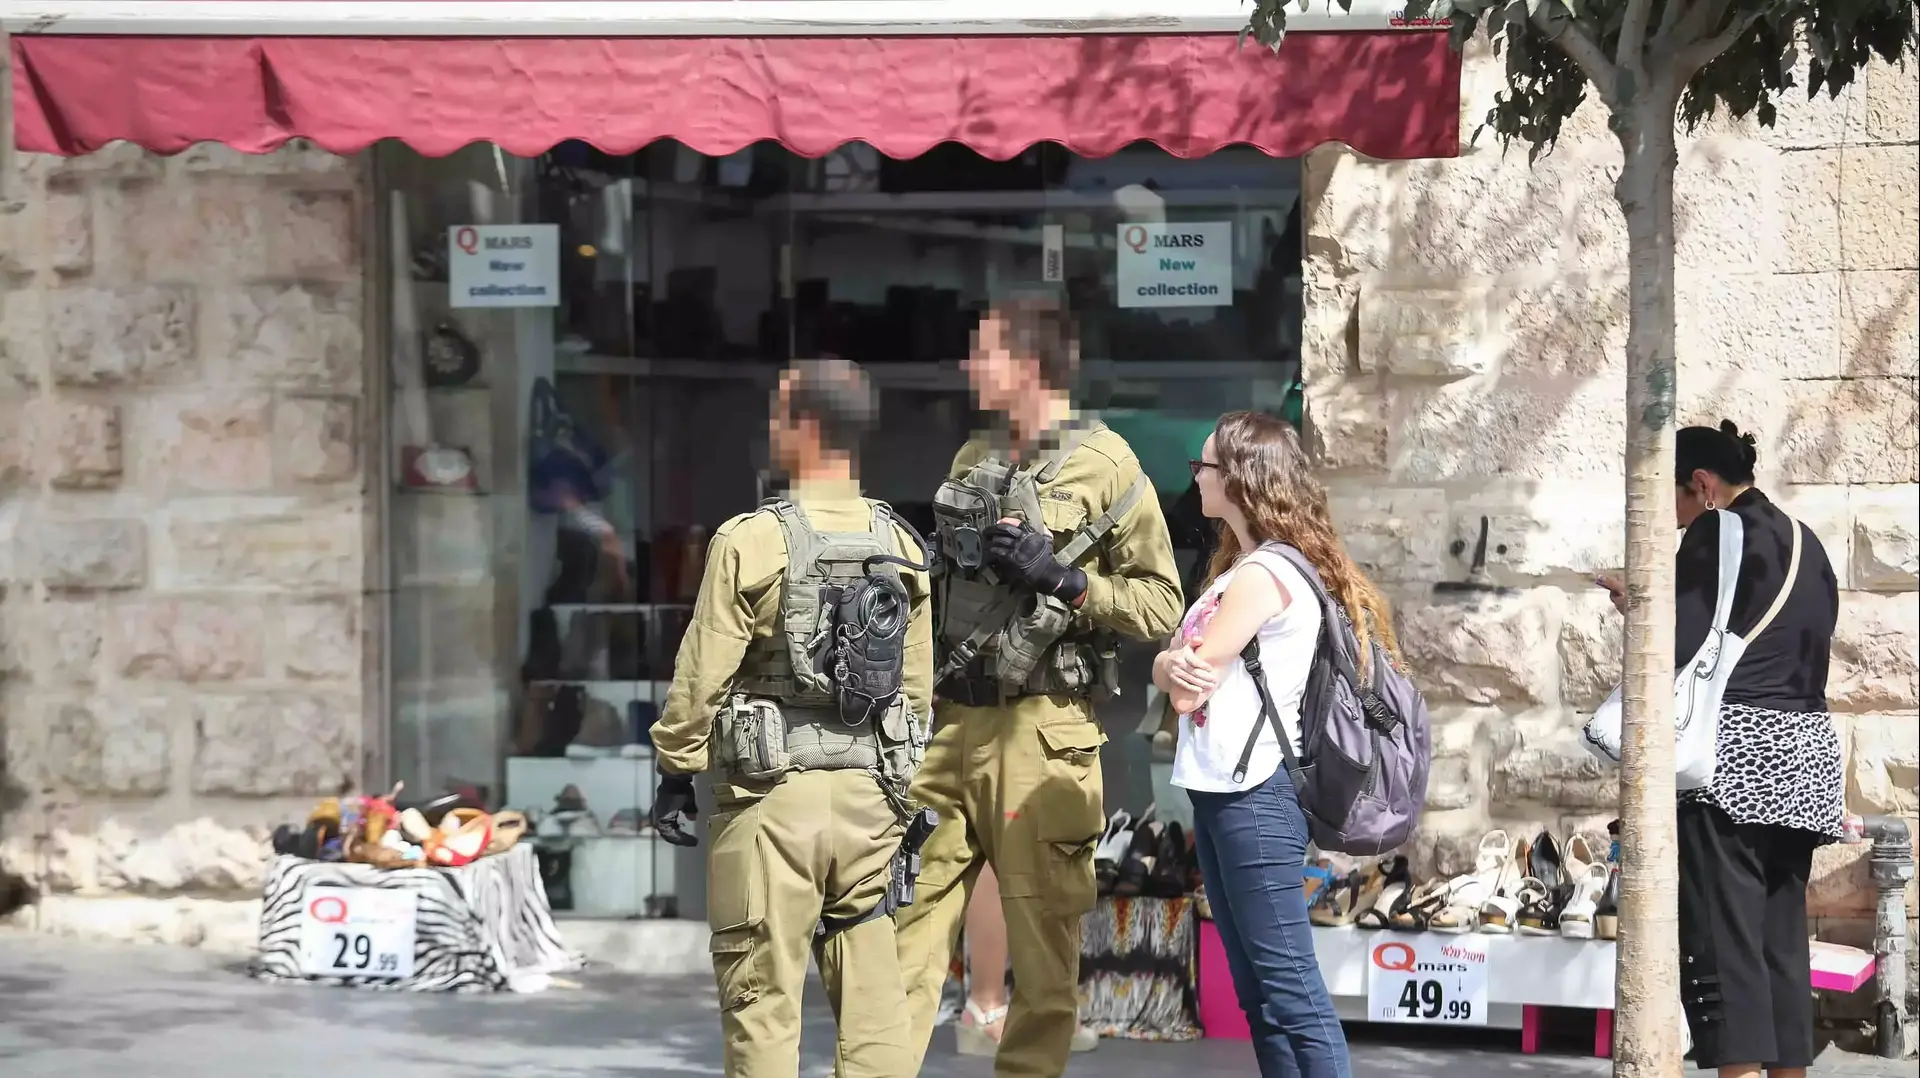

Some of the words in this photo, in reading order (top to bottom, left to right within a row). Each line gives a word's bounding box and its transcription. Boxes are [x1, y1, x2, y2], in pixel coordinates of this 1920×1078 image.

[457, 227, 478, 255] Q
[1125, 225, 1147, 254] Q
[1154, 234, 1204, 248] MARS
[1159, 258, 1195, 271] New
[1137, 283, 1218, 296] collection
[310, 896, 348, 924] Q
[1373, 942, 1416, 973] Q
[1418, 961, 1467, 972] mars
[1398, 979, 1471, 1019] 49.99
